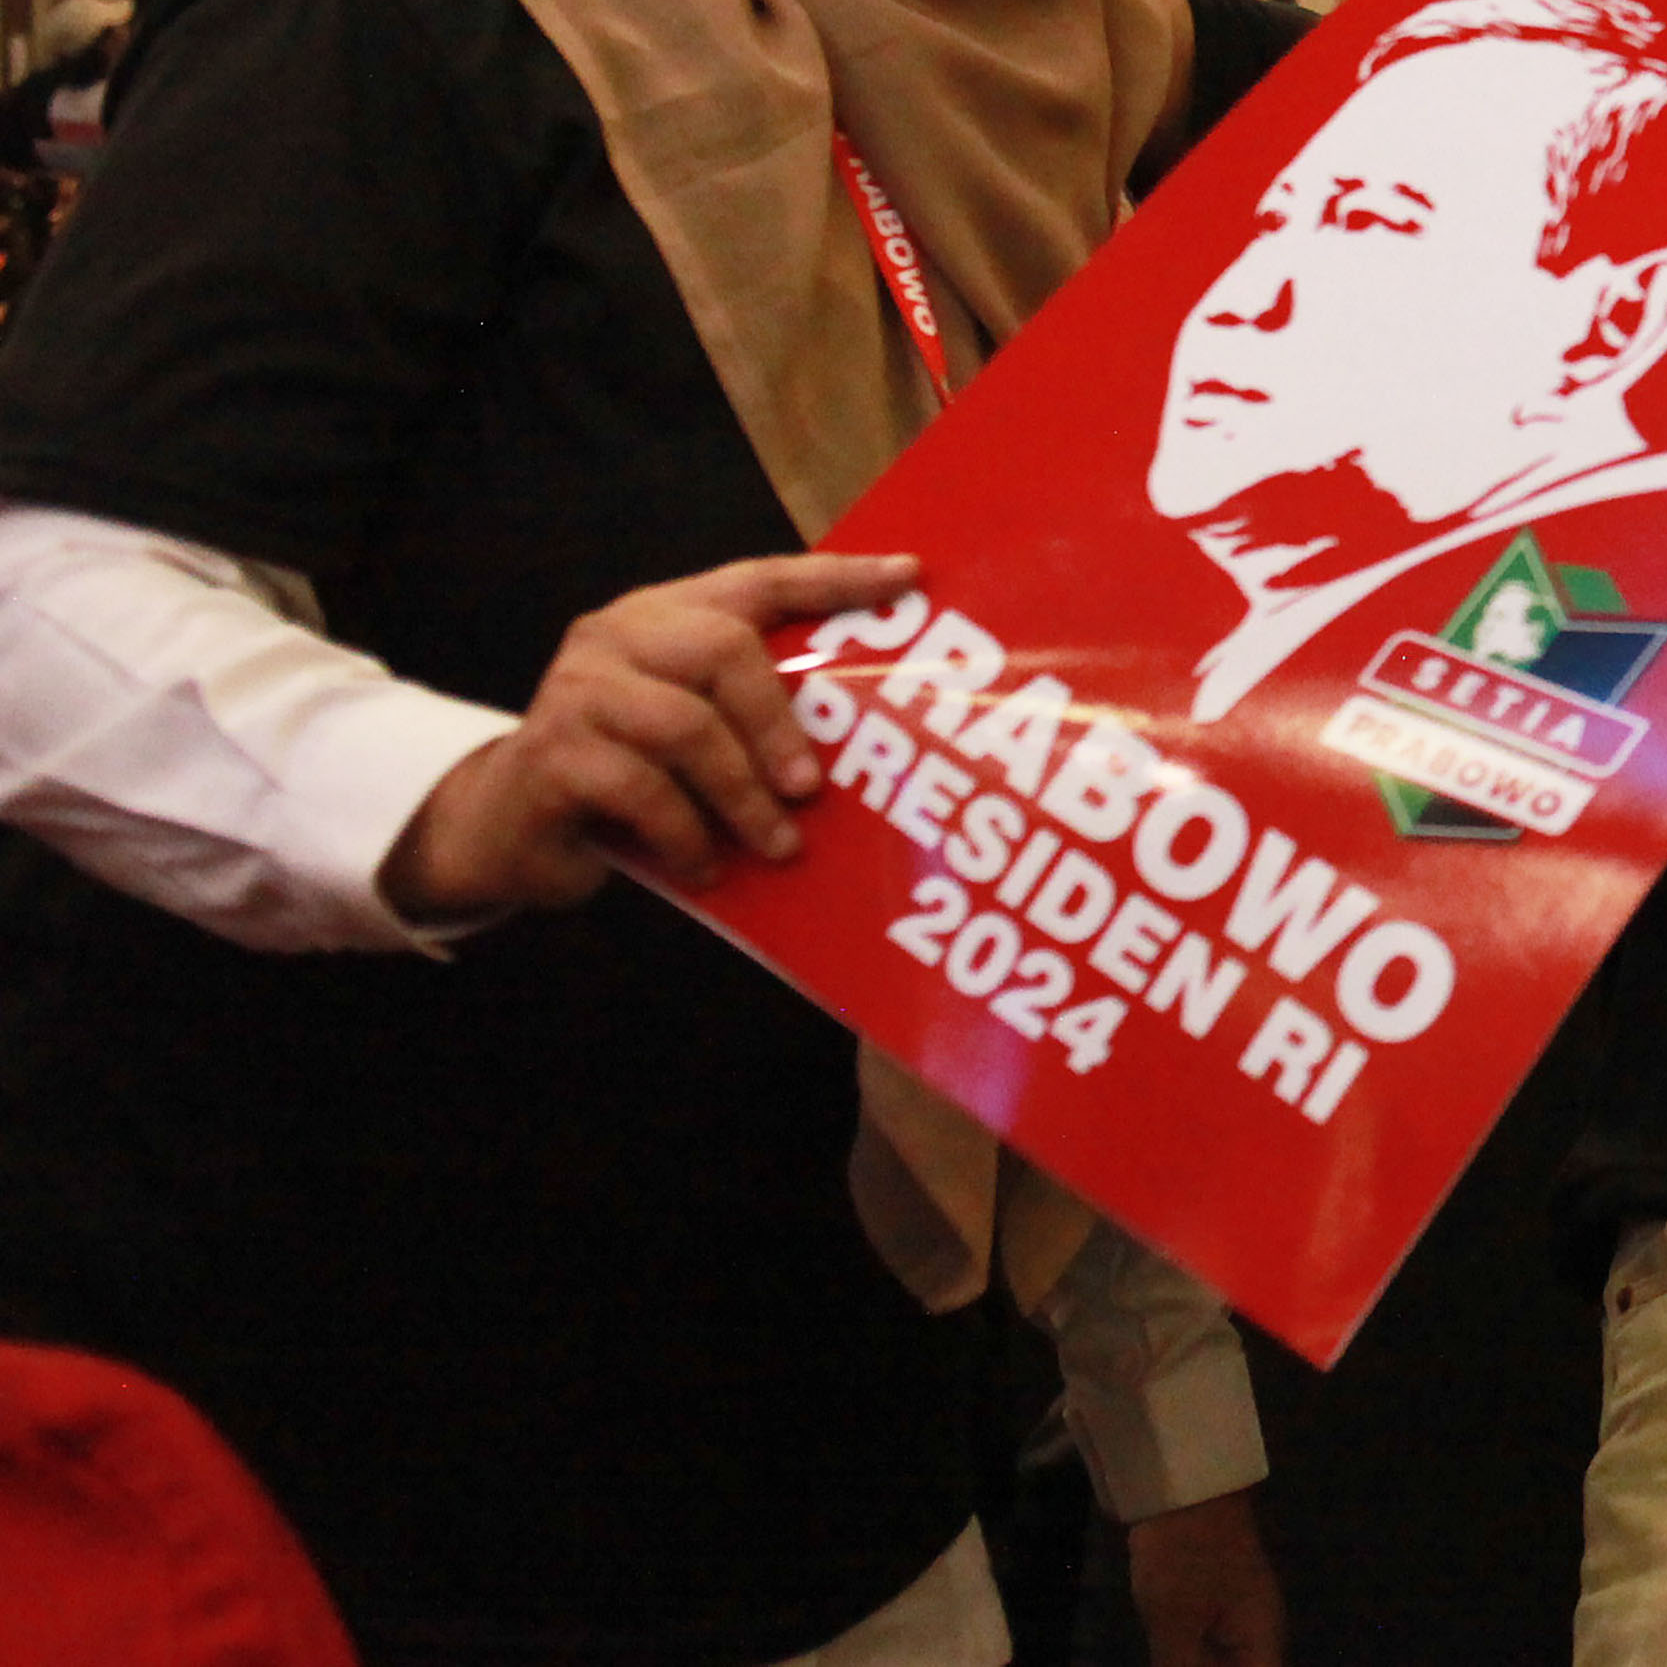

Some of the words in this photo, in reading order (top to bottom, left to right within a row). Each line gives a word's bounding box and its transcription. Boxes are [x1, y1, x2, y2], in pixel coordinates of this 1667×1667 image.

[807, 591, 1456, 1043] PRABOWO
[1411, 657, 1588, 752] SETIA
[792, 673, 1247, 1039] PRESIDEN
[1237, 996, 1369, 1125] RI
[886, 875, 1129, 1074] 2024
